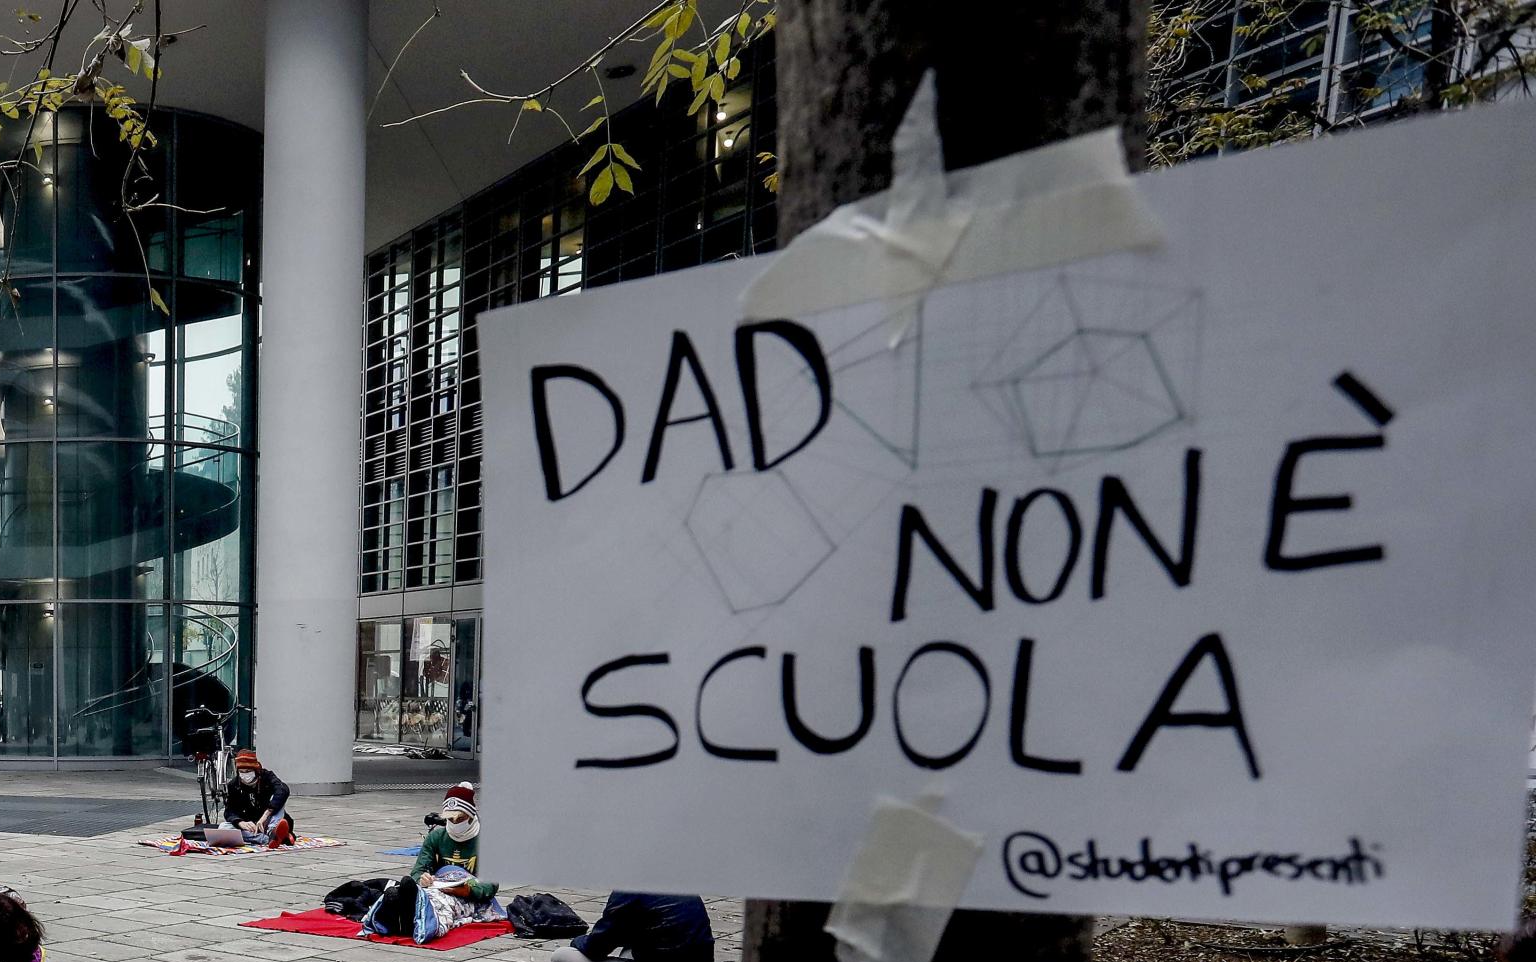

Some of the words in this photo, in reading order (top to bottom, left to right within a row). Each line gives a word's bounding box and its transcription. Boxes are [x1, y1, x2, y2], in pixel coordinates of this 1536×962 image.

[529, 317, 834, 502] DAD
[889, 447, 1205, 622] NON
[1263, 369, 1396, 575] È
[574, 632, 1262, 780] SCUOLA
